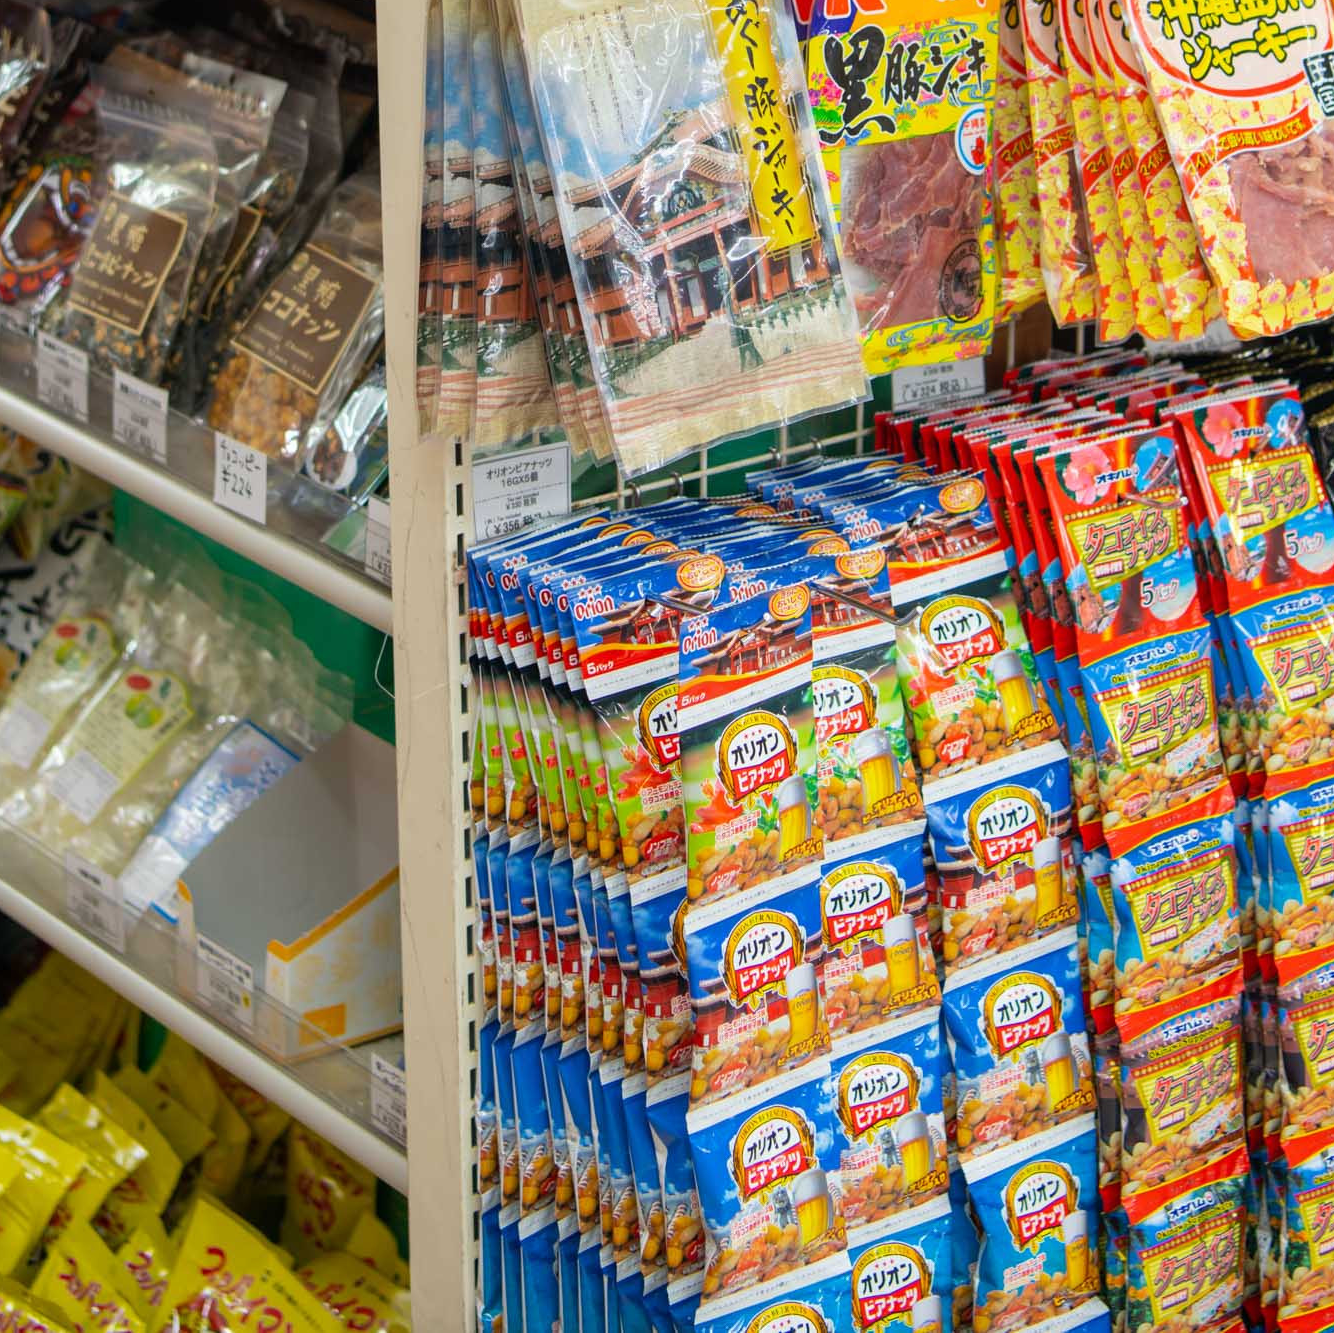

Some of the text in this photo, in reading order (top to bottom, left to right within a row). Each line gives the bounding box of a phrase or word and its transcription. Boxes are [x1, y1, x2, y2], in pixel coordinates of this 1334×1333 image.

[1181, 19, 1318, 82] ジャーキー
[262, 288, 343, 344] ココナッツ
[221, 467, 253, 498] ¥224
[1095, 469, 1131, 484] オキハム
[1264, 480, 1310, 521] ナッツ
[494, 519, 520, 534] ¥356
[1083, 507, 1167, 564] タコライス
[1125, 526, 1170, 569] ナッツ
[574, 596, 615, 622] Orion
[682, 626, 718, 656] Orion
[932, 611, 983, 643] オリオン
[942, 632, 995, 665] ビアナッツ
[586, 661, 615, 676] 5パック
[680, 692, 706, 708] 5パック
[1117, 678, 1203, 743] タコライス
[818, 708, 864, 739] アナッツ
[1161, 697, 1207, 745] ナッツ
[730, 731, 779, 767] オリオン
[737, 757, 786, 794] ビアナッツ
[980, 805, 1030, 837] オリオン
[985, 828, 1038, 862] ビアナッツ
[830, 880, 884, 914] オリオン
[1140, 866, 1224, 933] タコライス
[1181, 884, 1227, 933] ナッツ
[833, 905, 890, 939] ビアナッツ
[736, 929, 786, 966] オリオン
[739, 956, 791, 993] ビアナッツ
[996, 989, 1046, 1024] オリオン
[1000, 1014, 1051, 1048] ビアナッツ
[851, 1070, 902, 1104] オリオン
[1149, 1047, 1232, 1118] タコライス
[854, 1093, 907, 1129] ビアナッツ
[746, 1125, 792, 1163] オリオン
[1017, 1179, 1061, 1213] オリオン
[1020, 1202, 1067, 1238] ビアナッツ
[860, 1260, 914, 1295] オリオン
[864, 1286, 919, 1322] ビアナッツ
